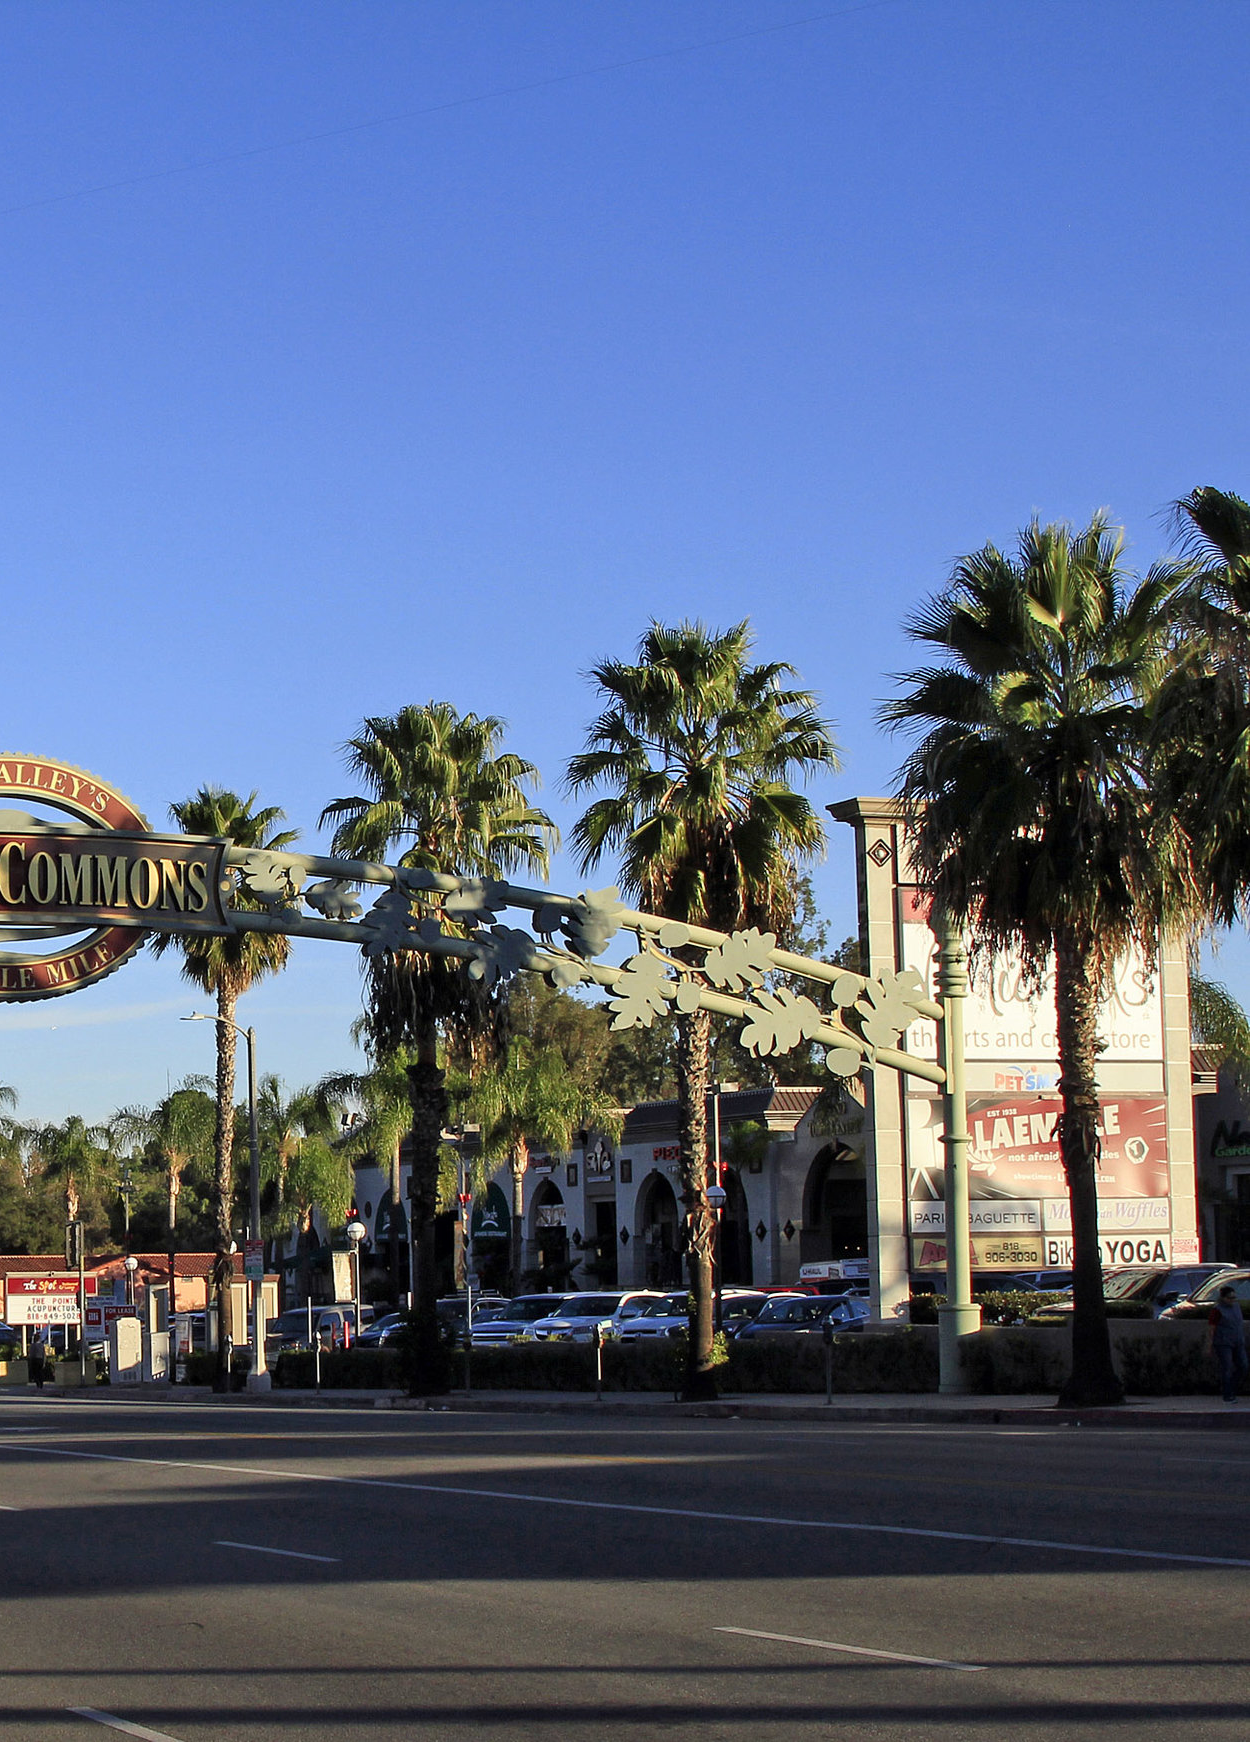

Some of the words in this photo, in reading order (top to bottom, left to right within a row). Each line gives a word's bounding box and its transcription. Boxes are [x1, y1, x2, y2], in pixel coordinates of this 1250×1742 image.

[45, 940, 116, 985] MILE
[912, 1026, 937, 1048] th
[964, 1028, 990, 1048] rts
[995, 1026, 1033, 1048] and
[987, 1109, 1000, 1118] EST
[1001, 1107, 1018, 1117] 1938
[1008, 1153, 1025, 1162] not
[1028, 1151, 1060, 1162] afraid
[914, 1212, 945, 1224] PARI
[1115, 1201, 1168, 1227] Waffles
[1002, 1242, 1019, 1250] 818
[1105, 1239, 1167, 1264] YOGA
[985, 1251, 1038, 1263] 906-3030
